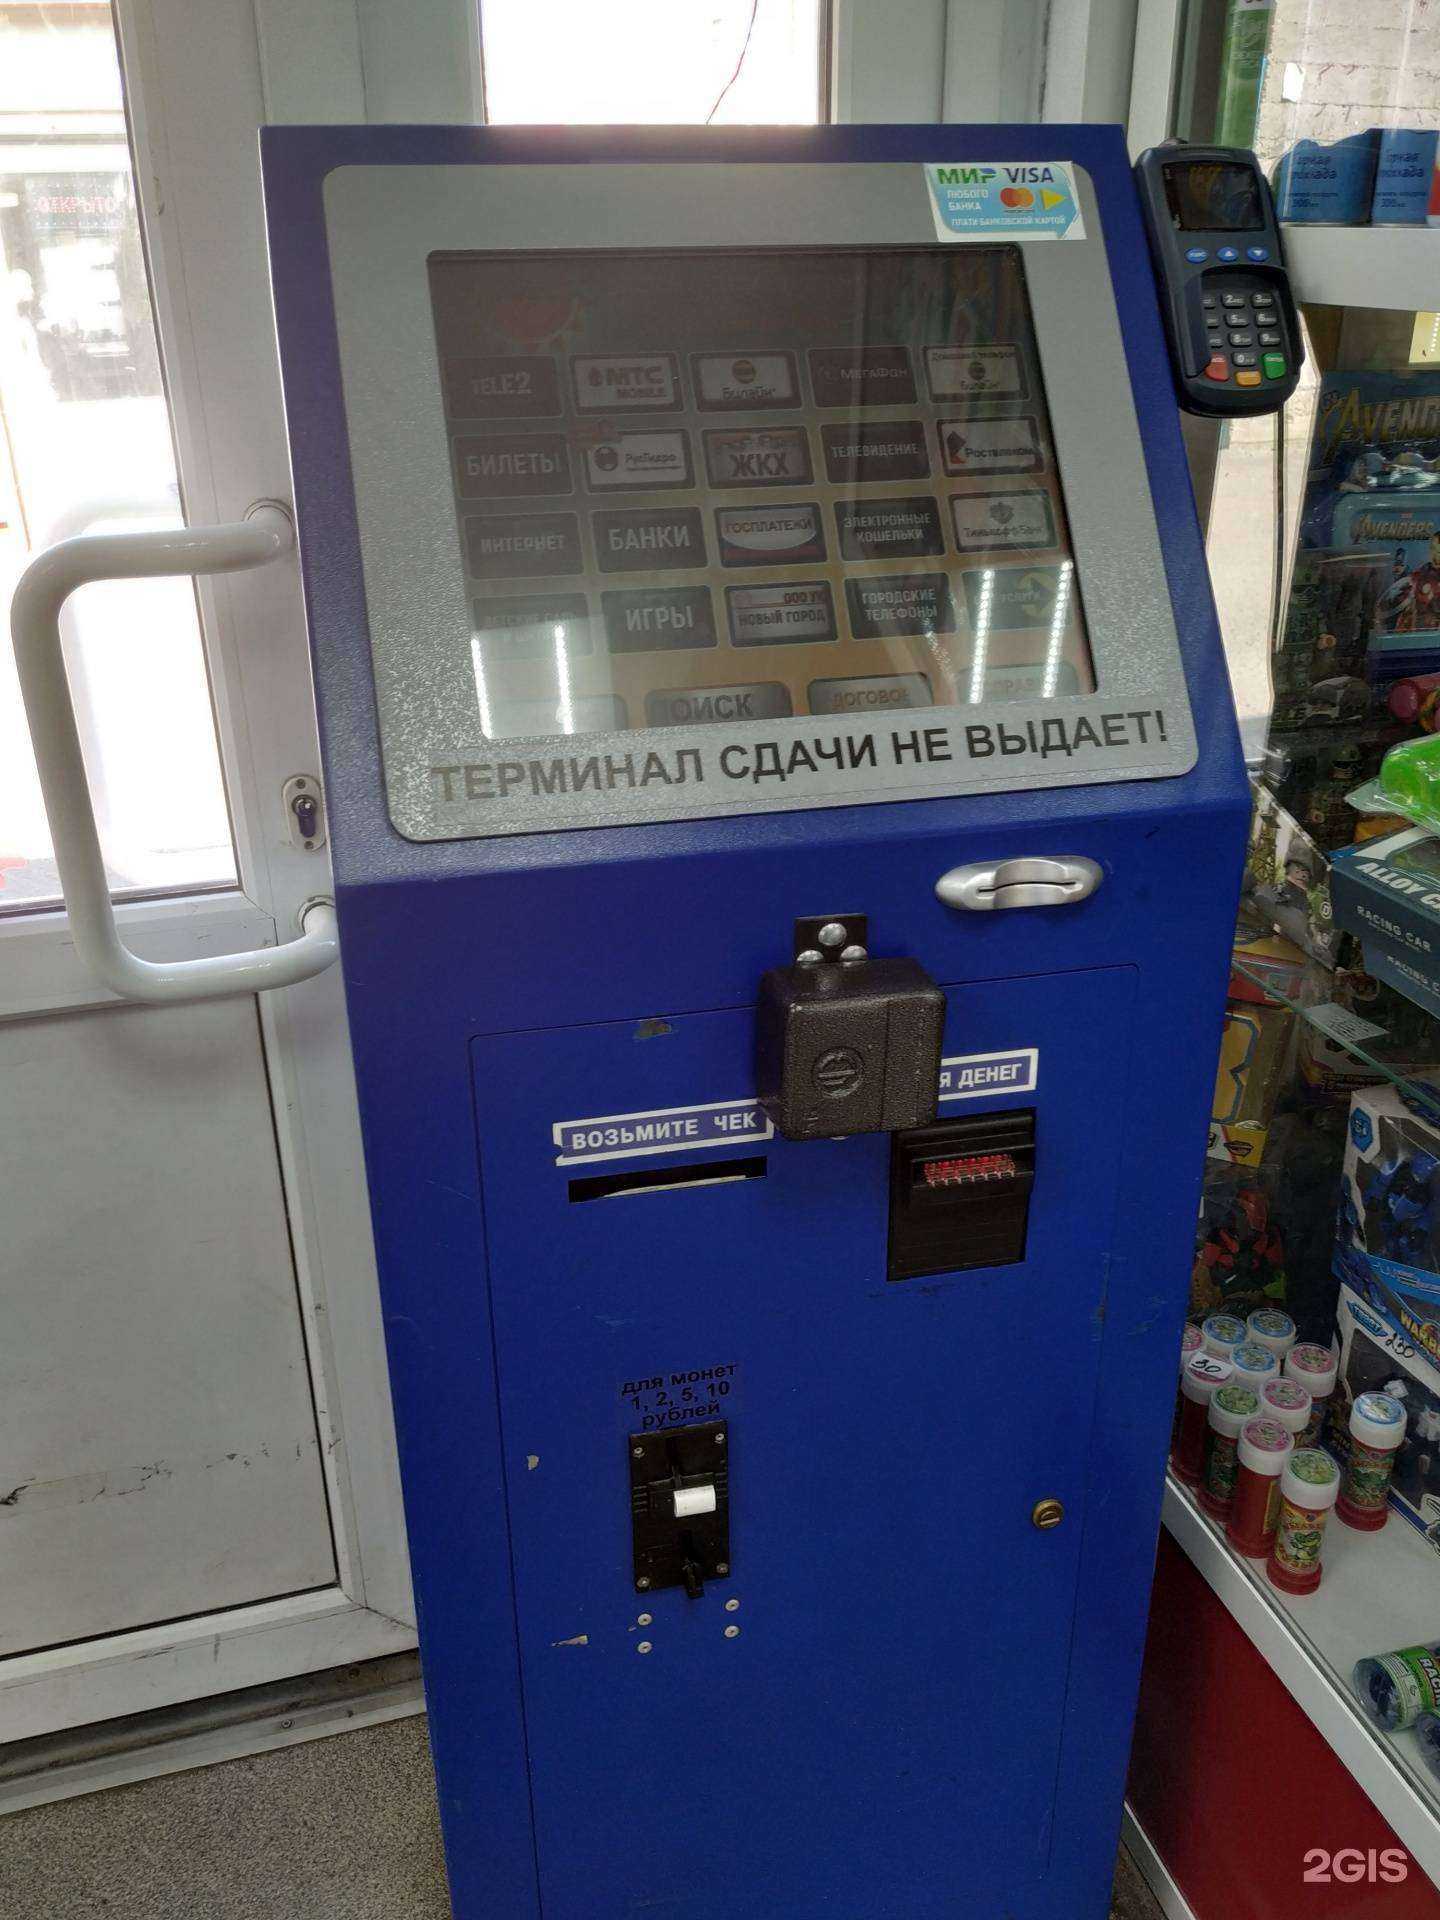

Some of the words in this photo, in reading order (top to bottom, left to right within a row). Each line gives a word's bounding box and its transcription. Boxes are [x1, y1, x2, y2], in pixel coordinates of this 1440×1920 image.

[937, 168, 996, 184] МИР
[1002, 167, 1054, 183] VISA
[948, 202, 982, 211] БАНКА
[831, 443, 920, 459] ТЕЛЕВИДЕНИЕ
[465, 451, 562, 477] БИЛЕТЫ
[729, 452, 789, 477] ЖКХ
[844, 513, 931, 529] ЭЛЕКТРОННЫЕ
[481, 534, 566, 553] ИНТЕРНЕТ
[608, 525, 692, 551] БАНКИ
[856, 527, 925, 544] КОШЕЛЬКИ
[861, 588, 937, 605] ГОРОДСКИЕ
[625, 605, 695, 632] ИГРЫ
[738, 609, 783, 626] НОВЫЙ
[785, 609, 826, 624] ГОРОД
[864, 606, 938, 621] ТЕЛЕФОНЫ
[663, 694, 754, 722] ОИСК
[431, 748, 705, 801] ТЕРМИНАЛ
[720, 735, 878, 784] СДАЧИ
[892, 728, 952, 765] НЕ
[965, 710, 1168, 759] ВЫДАЕТ!
[1355, 862, 1428, 895] ALLOY
[1357, 905, 1402, 936] RACING
[1405, 932, 1432, 953] CAR
[958, 1063, 1022, 1089] ДЕНЕГ
[572, 1119, 699, 1150] ВОЗЬМИТЕ
[714, 1111, 757, 1132] ЧЕК
[671, 1363, 738, 1387] монет
[1191, 1358, 1221, 1373] 30
[706, 1381, 730, 1397] 10
[642, 1400, 720, 1430] рублей
